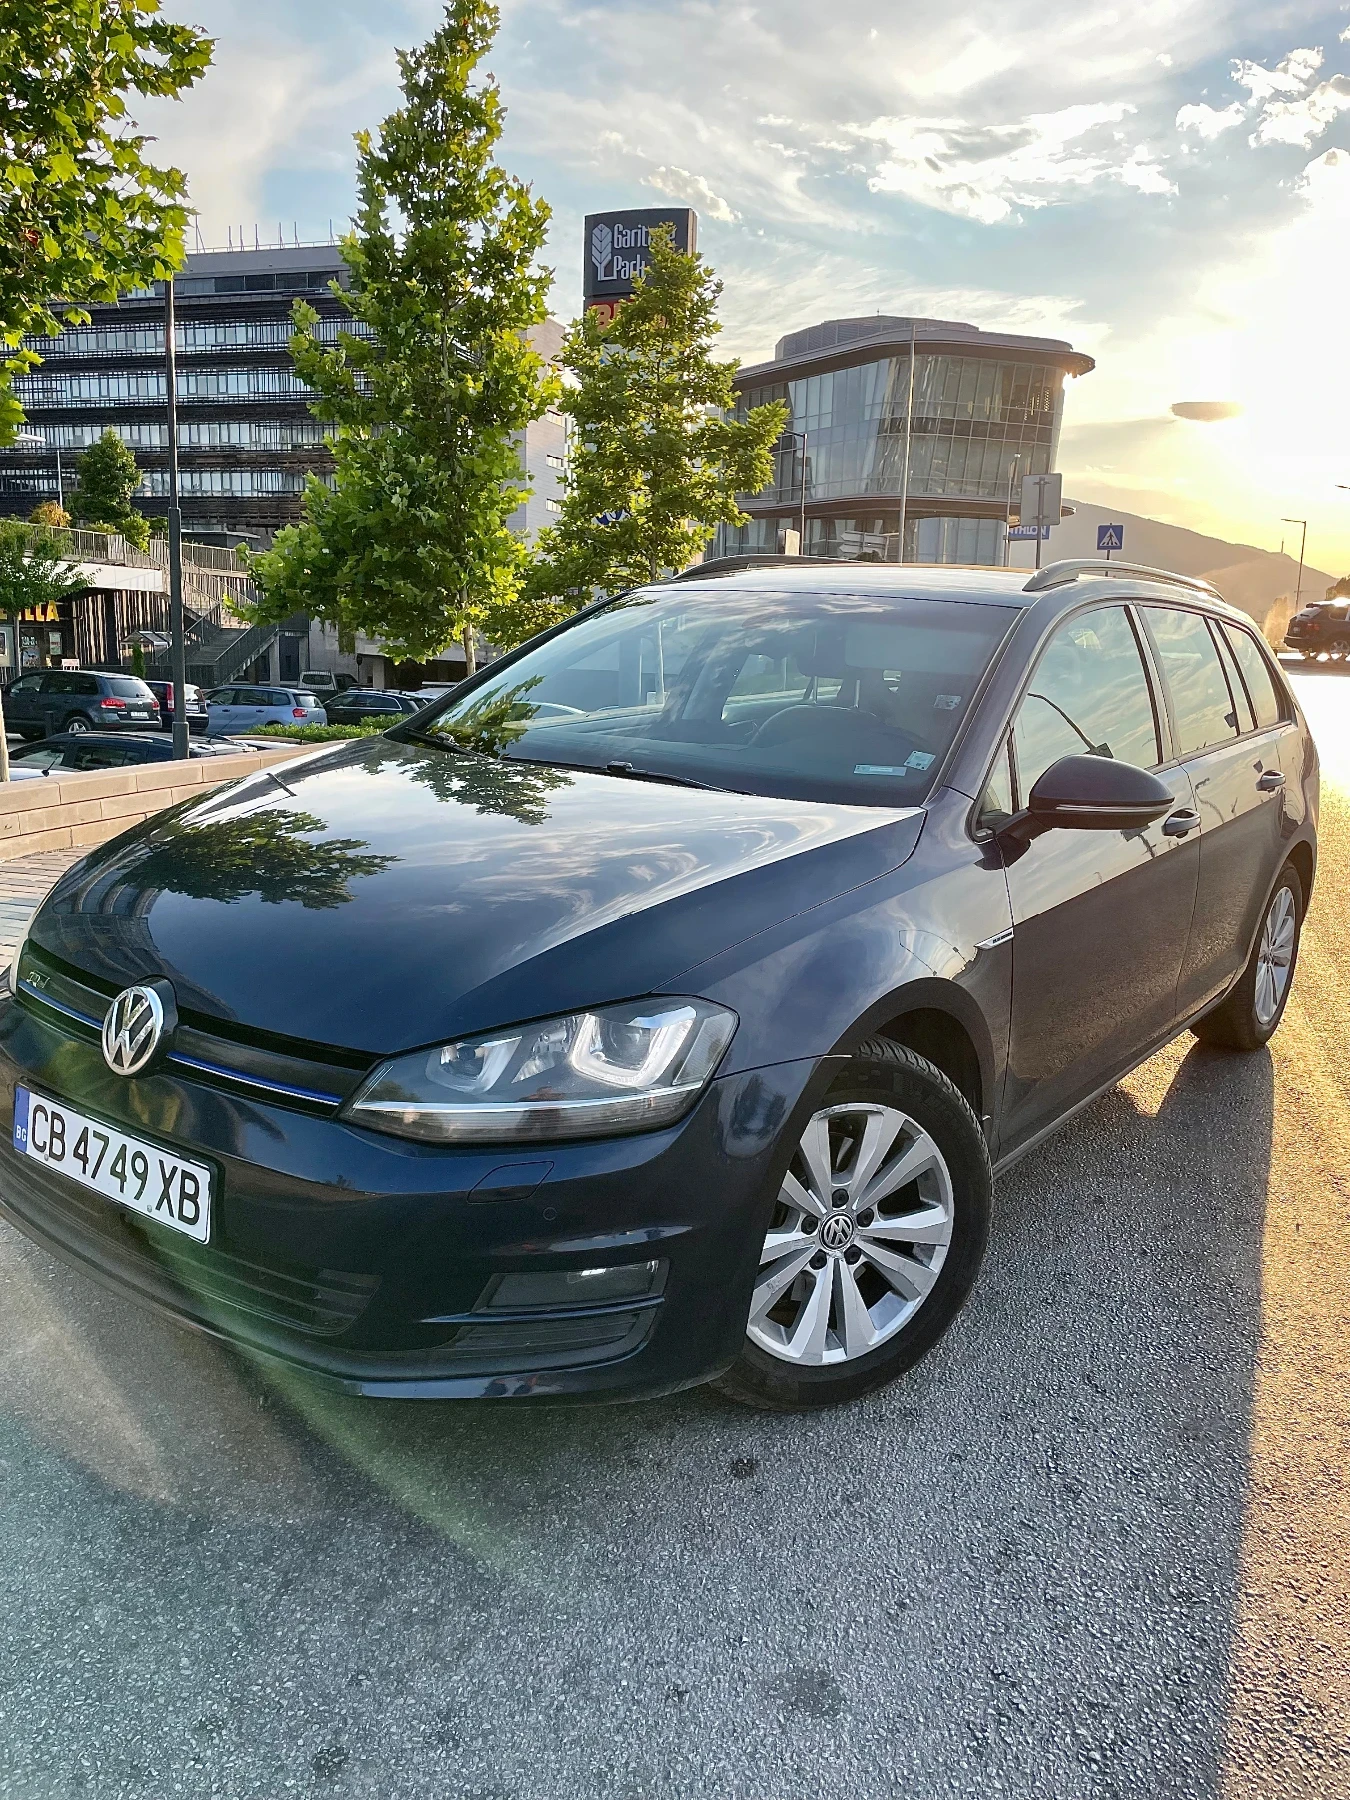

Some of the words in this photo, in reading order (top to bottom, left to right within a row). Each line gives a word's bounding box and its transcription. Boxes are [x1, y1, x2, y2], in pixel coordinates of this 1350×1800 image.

[613, 254, 646, 280] Park
[15, 1124, 27, 1142] BG
[31, 1104, 66, 1162] CB
[73, 1126, 150, 1201] 4749
[155, 1158, 201, 1226] XB
